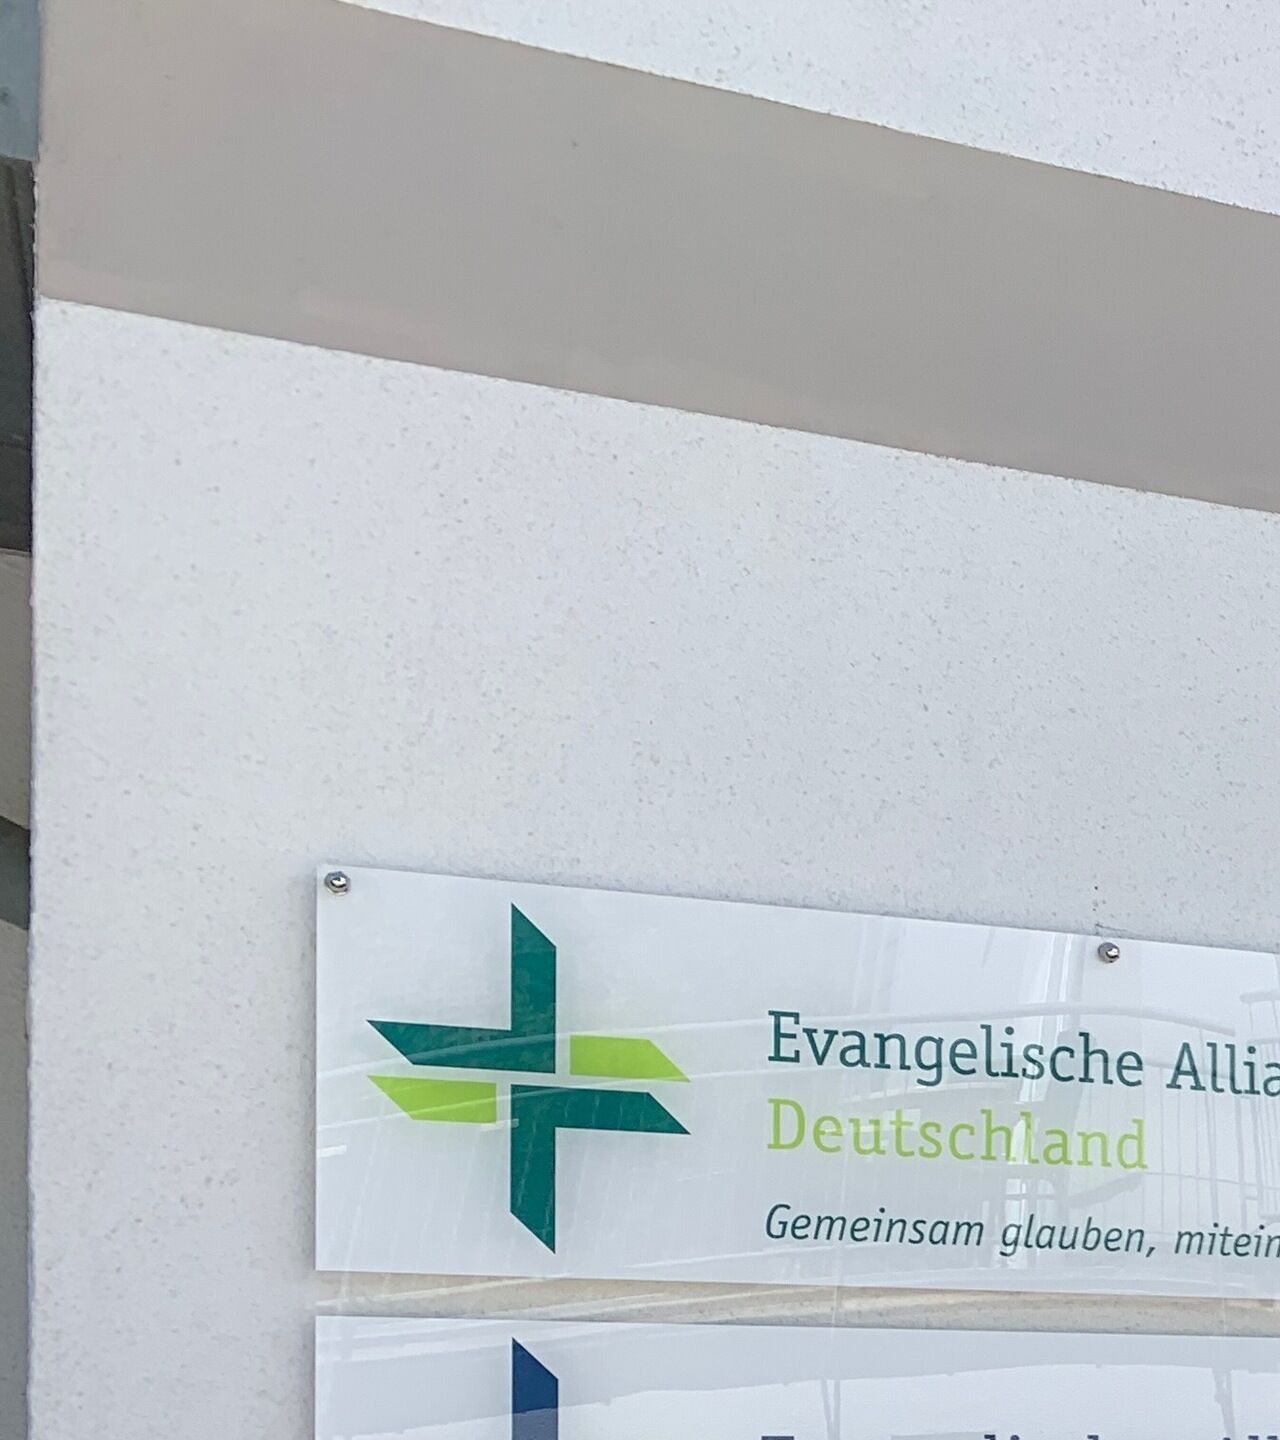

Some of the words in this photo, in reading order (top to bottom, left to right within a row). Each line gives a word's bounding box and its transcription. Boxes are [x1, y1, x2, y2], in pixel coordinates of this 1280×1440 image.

[768, 1011, 1143, 1086] Evangelische
[768, 1098, 1147, 1169] Deutschland
[767, 1204, 983, 1245] Gemeinsam
[1000, 1214, 1155, 1257] glauben,
